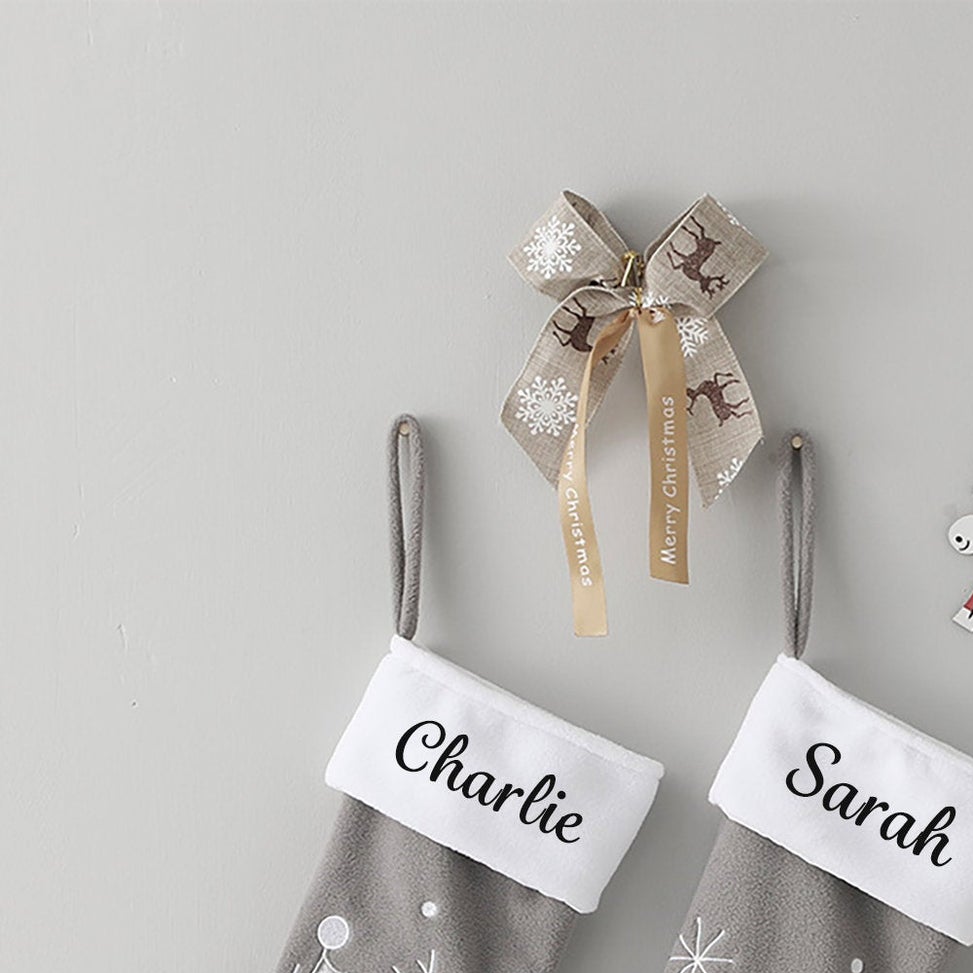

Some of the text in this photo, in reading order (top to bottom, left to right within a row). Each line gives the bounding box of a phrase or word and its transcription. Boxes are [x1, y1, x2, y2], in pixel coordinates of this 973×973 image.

[565, 487, 593, 587] Christmas
[660, 396, 681, 565] Merry Christmas
[395, 720, 583, 844] Charlie
[785, 742, 957, 867] Sarah
